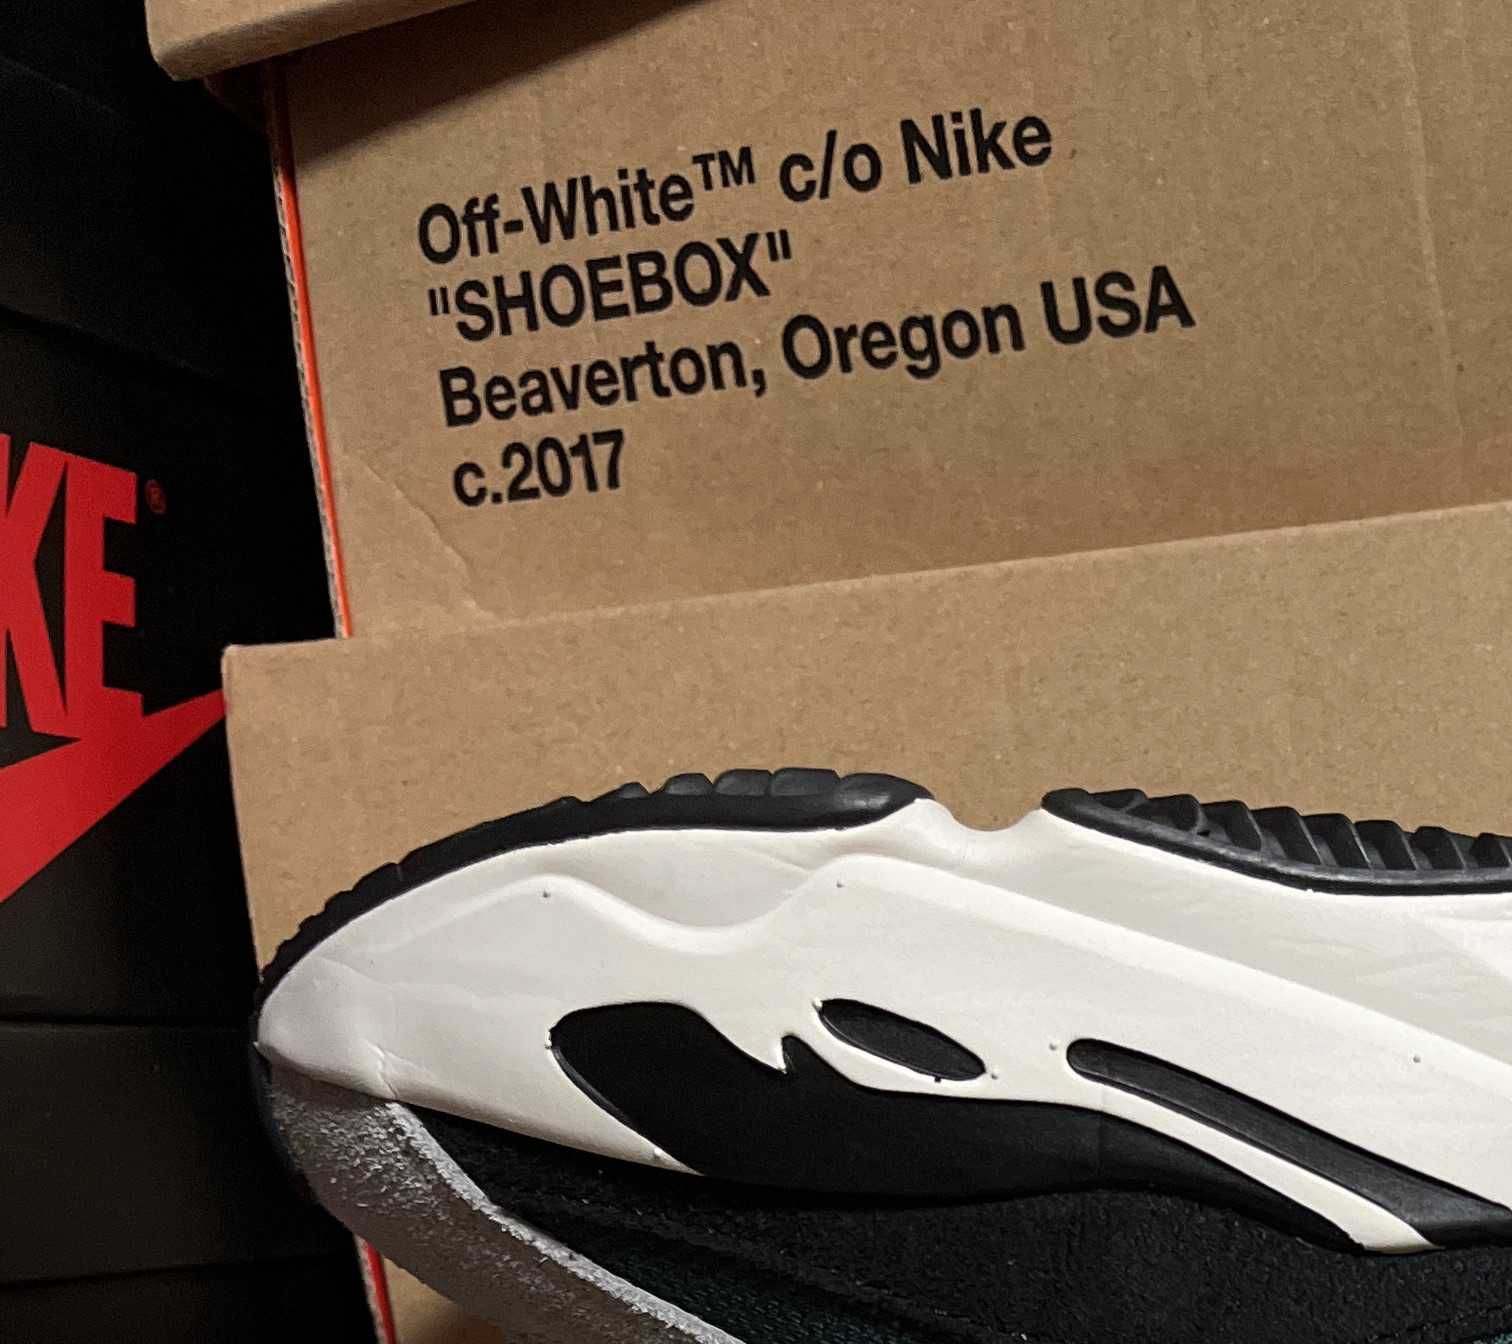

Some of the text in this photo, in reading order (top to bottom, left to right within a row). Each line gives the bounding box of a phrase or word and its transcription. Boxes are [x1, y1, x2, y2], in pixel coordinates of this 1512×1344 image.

[778, 130, 884, 203] c/o
[899, 107, 1054, 185] Nike
[428, 229, 791, 342] "SHOEBOX"
[439, 264, 1195, 427] Beaverton, Oregon USA
[453, 428, 626, 507] c.2017
